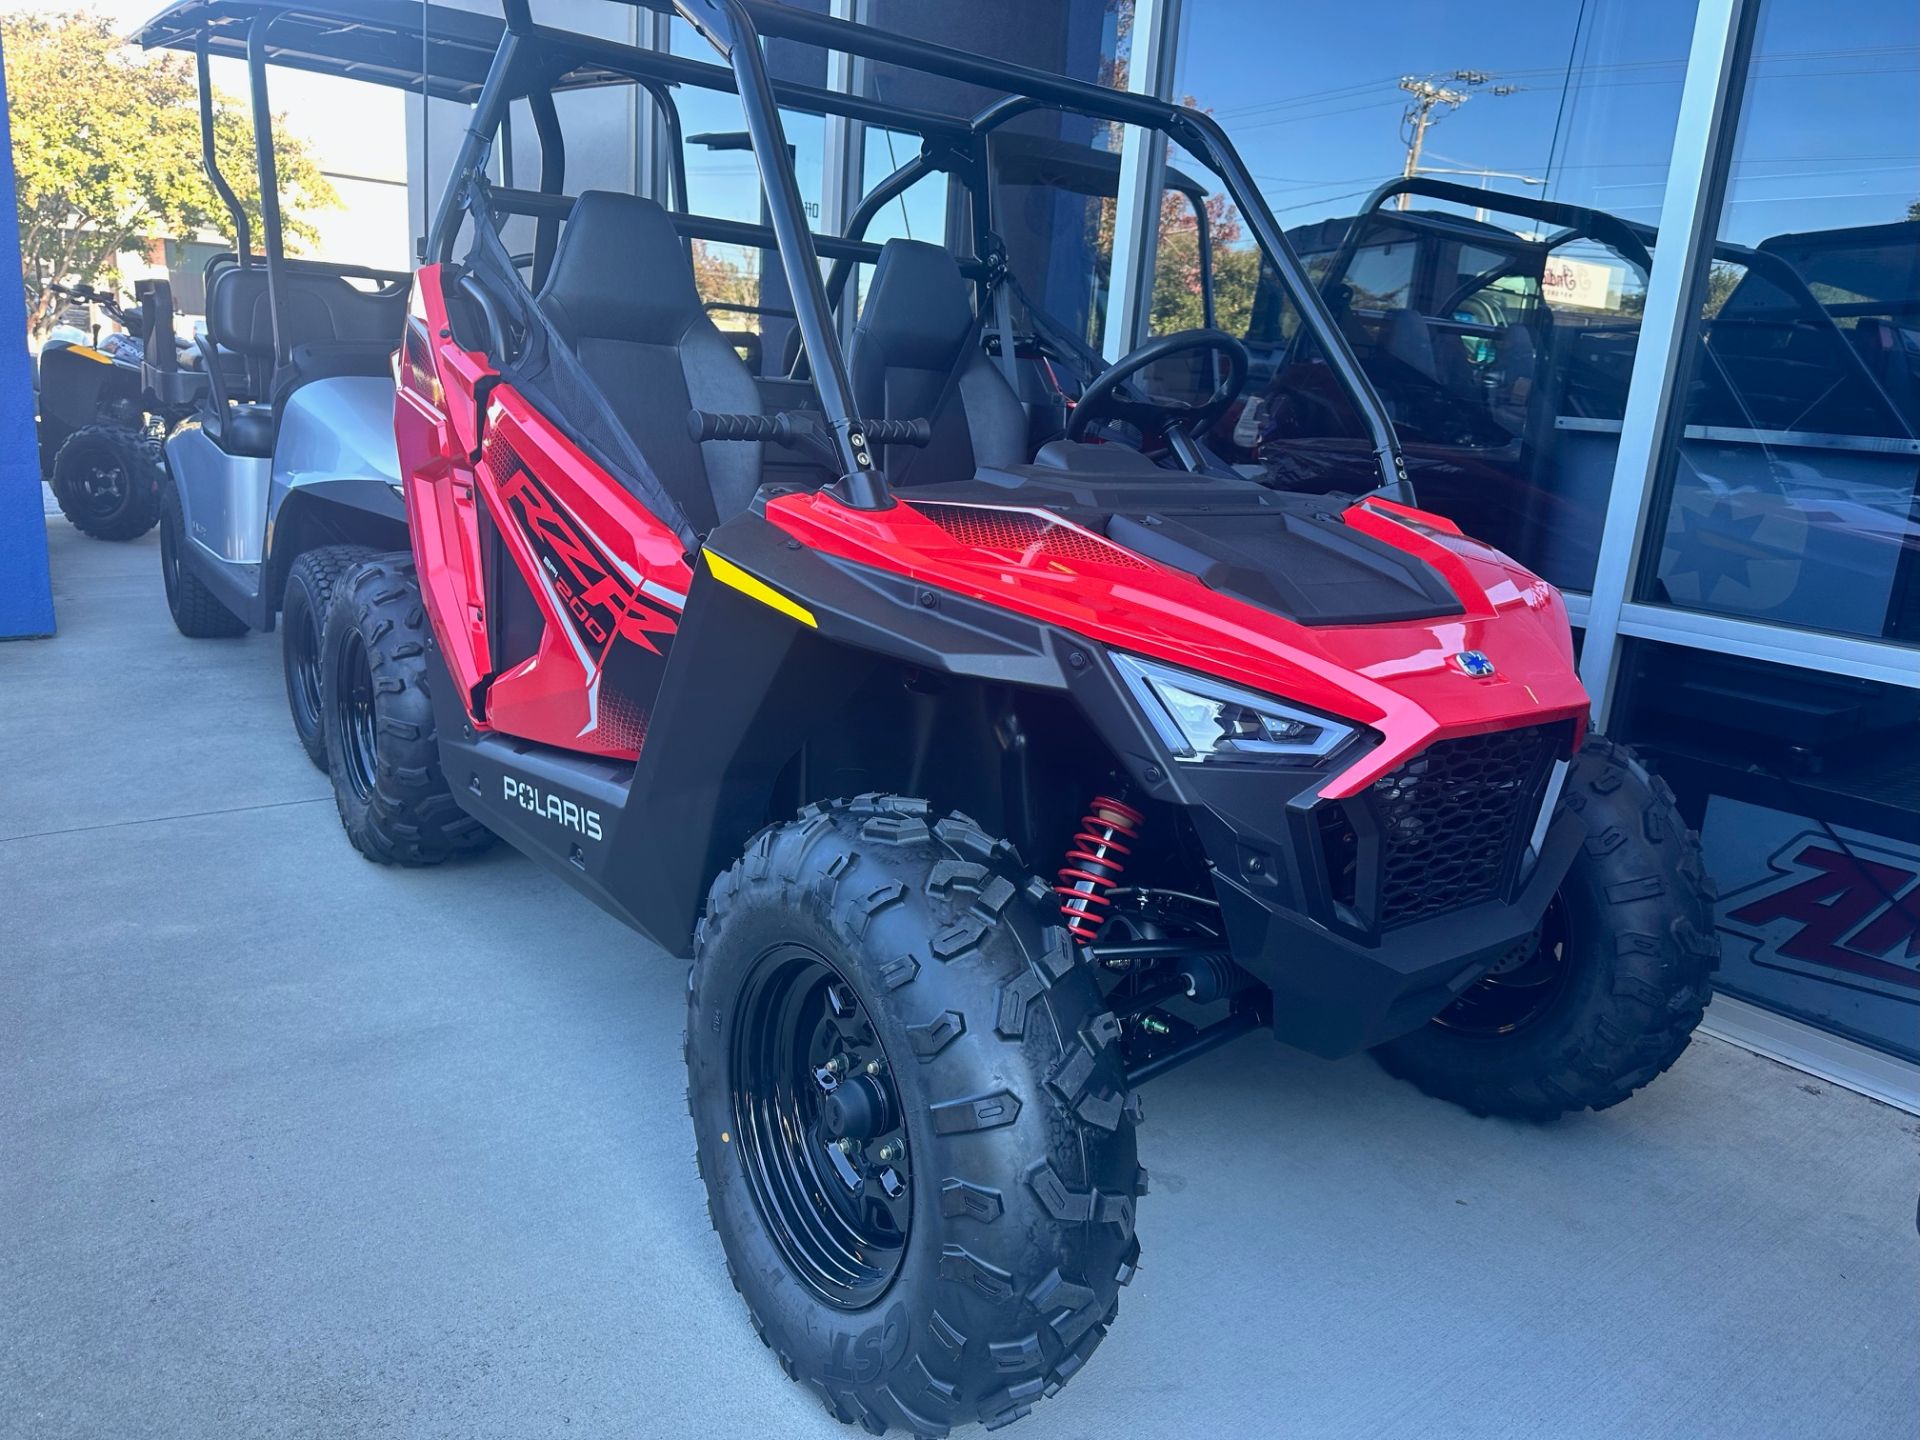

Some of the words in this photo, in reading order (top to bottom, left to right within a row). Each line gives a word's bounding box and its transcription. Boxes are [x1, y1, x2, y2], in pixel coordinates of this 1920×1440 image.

[500, 469, 678, 656] RZR
[556, 576, 607, 644] 200
[503, 775, 603, 841] POLARIS
[824, 1300, 910, 1384] CST
